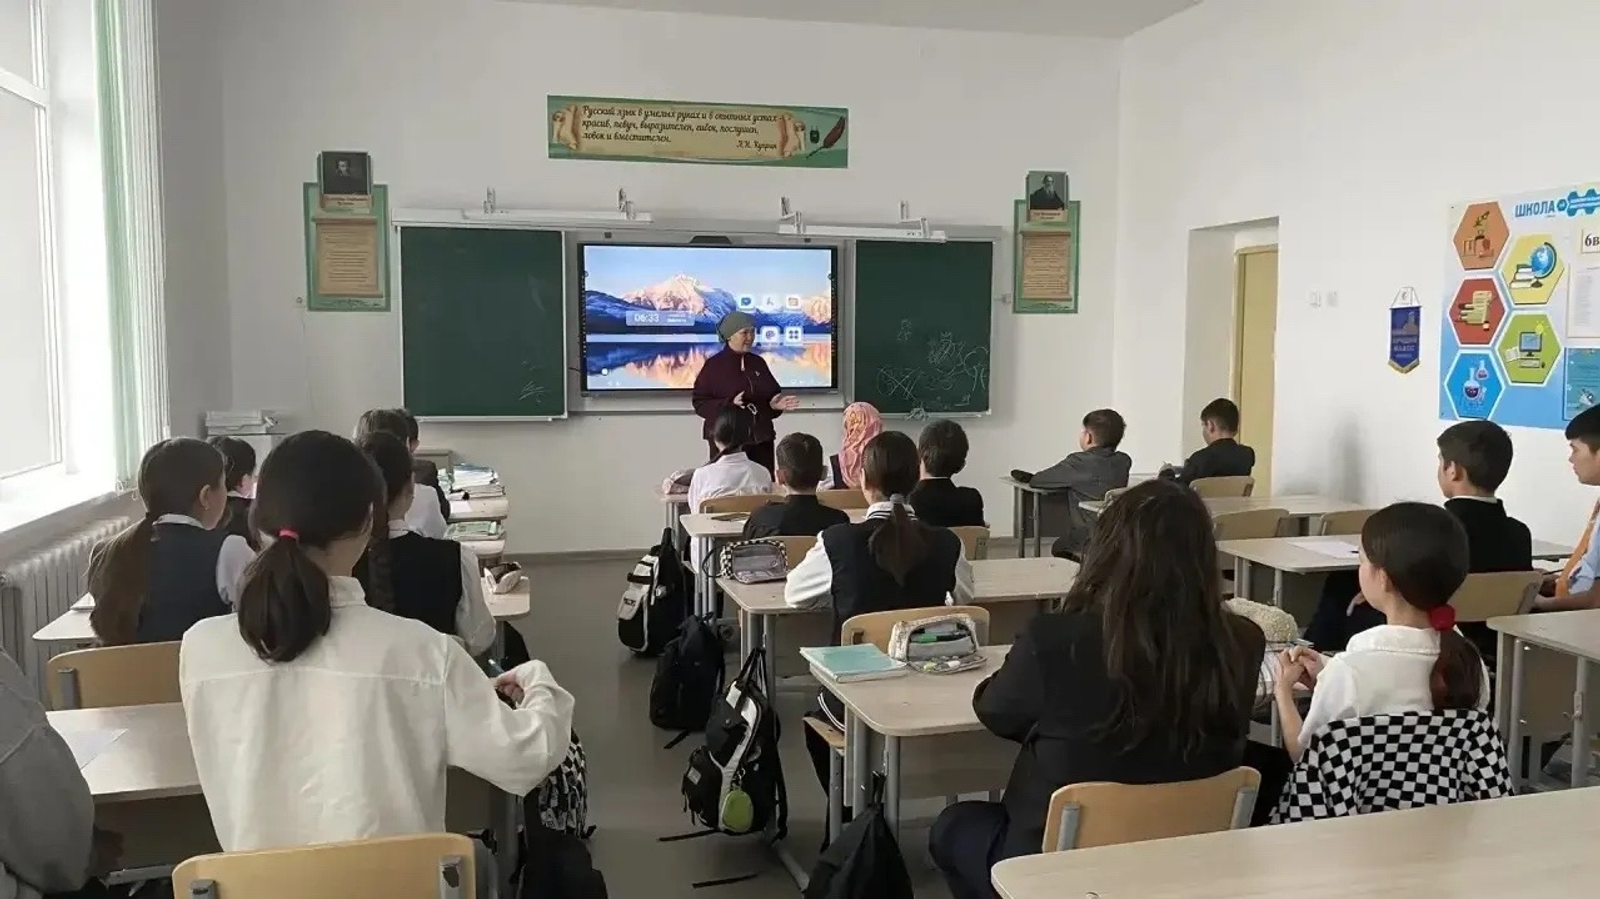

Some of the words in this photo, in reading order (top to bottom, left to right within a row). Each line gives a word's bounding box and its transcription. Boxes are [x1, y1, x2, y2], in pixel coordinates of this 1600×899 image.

[582, 105, 616, 118] Русский
[617, 108, 636, 120] язык
[644, 110, 676, 121] умелых
[676, 112, 700, 122] руках
[715, 113, 752, 122] опытных
[752, 115, 777, 125] устах
[582, 119, 612, 130] красив,
[613, 120, 638, 132] певуч,
[640, 120, 695, 133] выразителен,
[719, 125, 759, 136] послушен,
[582, 131, 605, 140] ловок
[1515, 200, 1555, 217] ШКОЛА
[634, 313, 660, 323] 06:33
